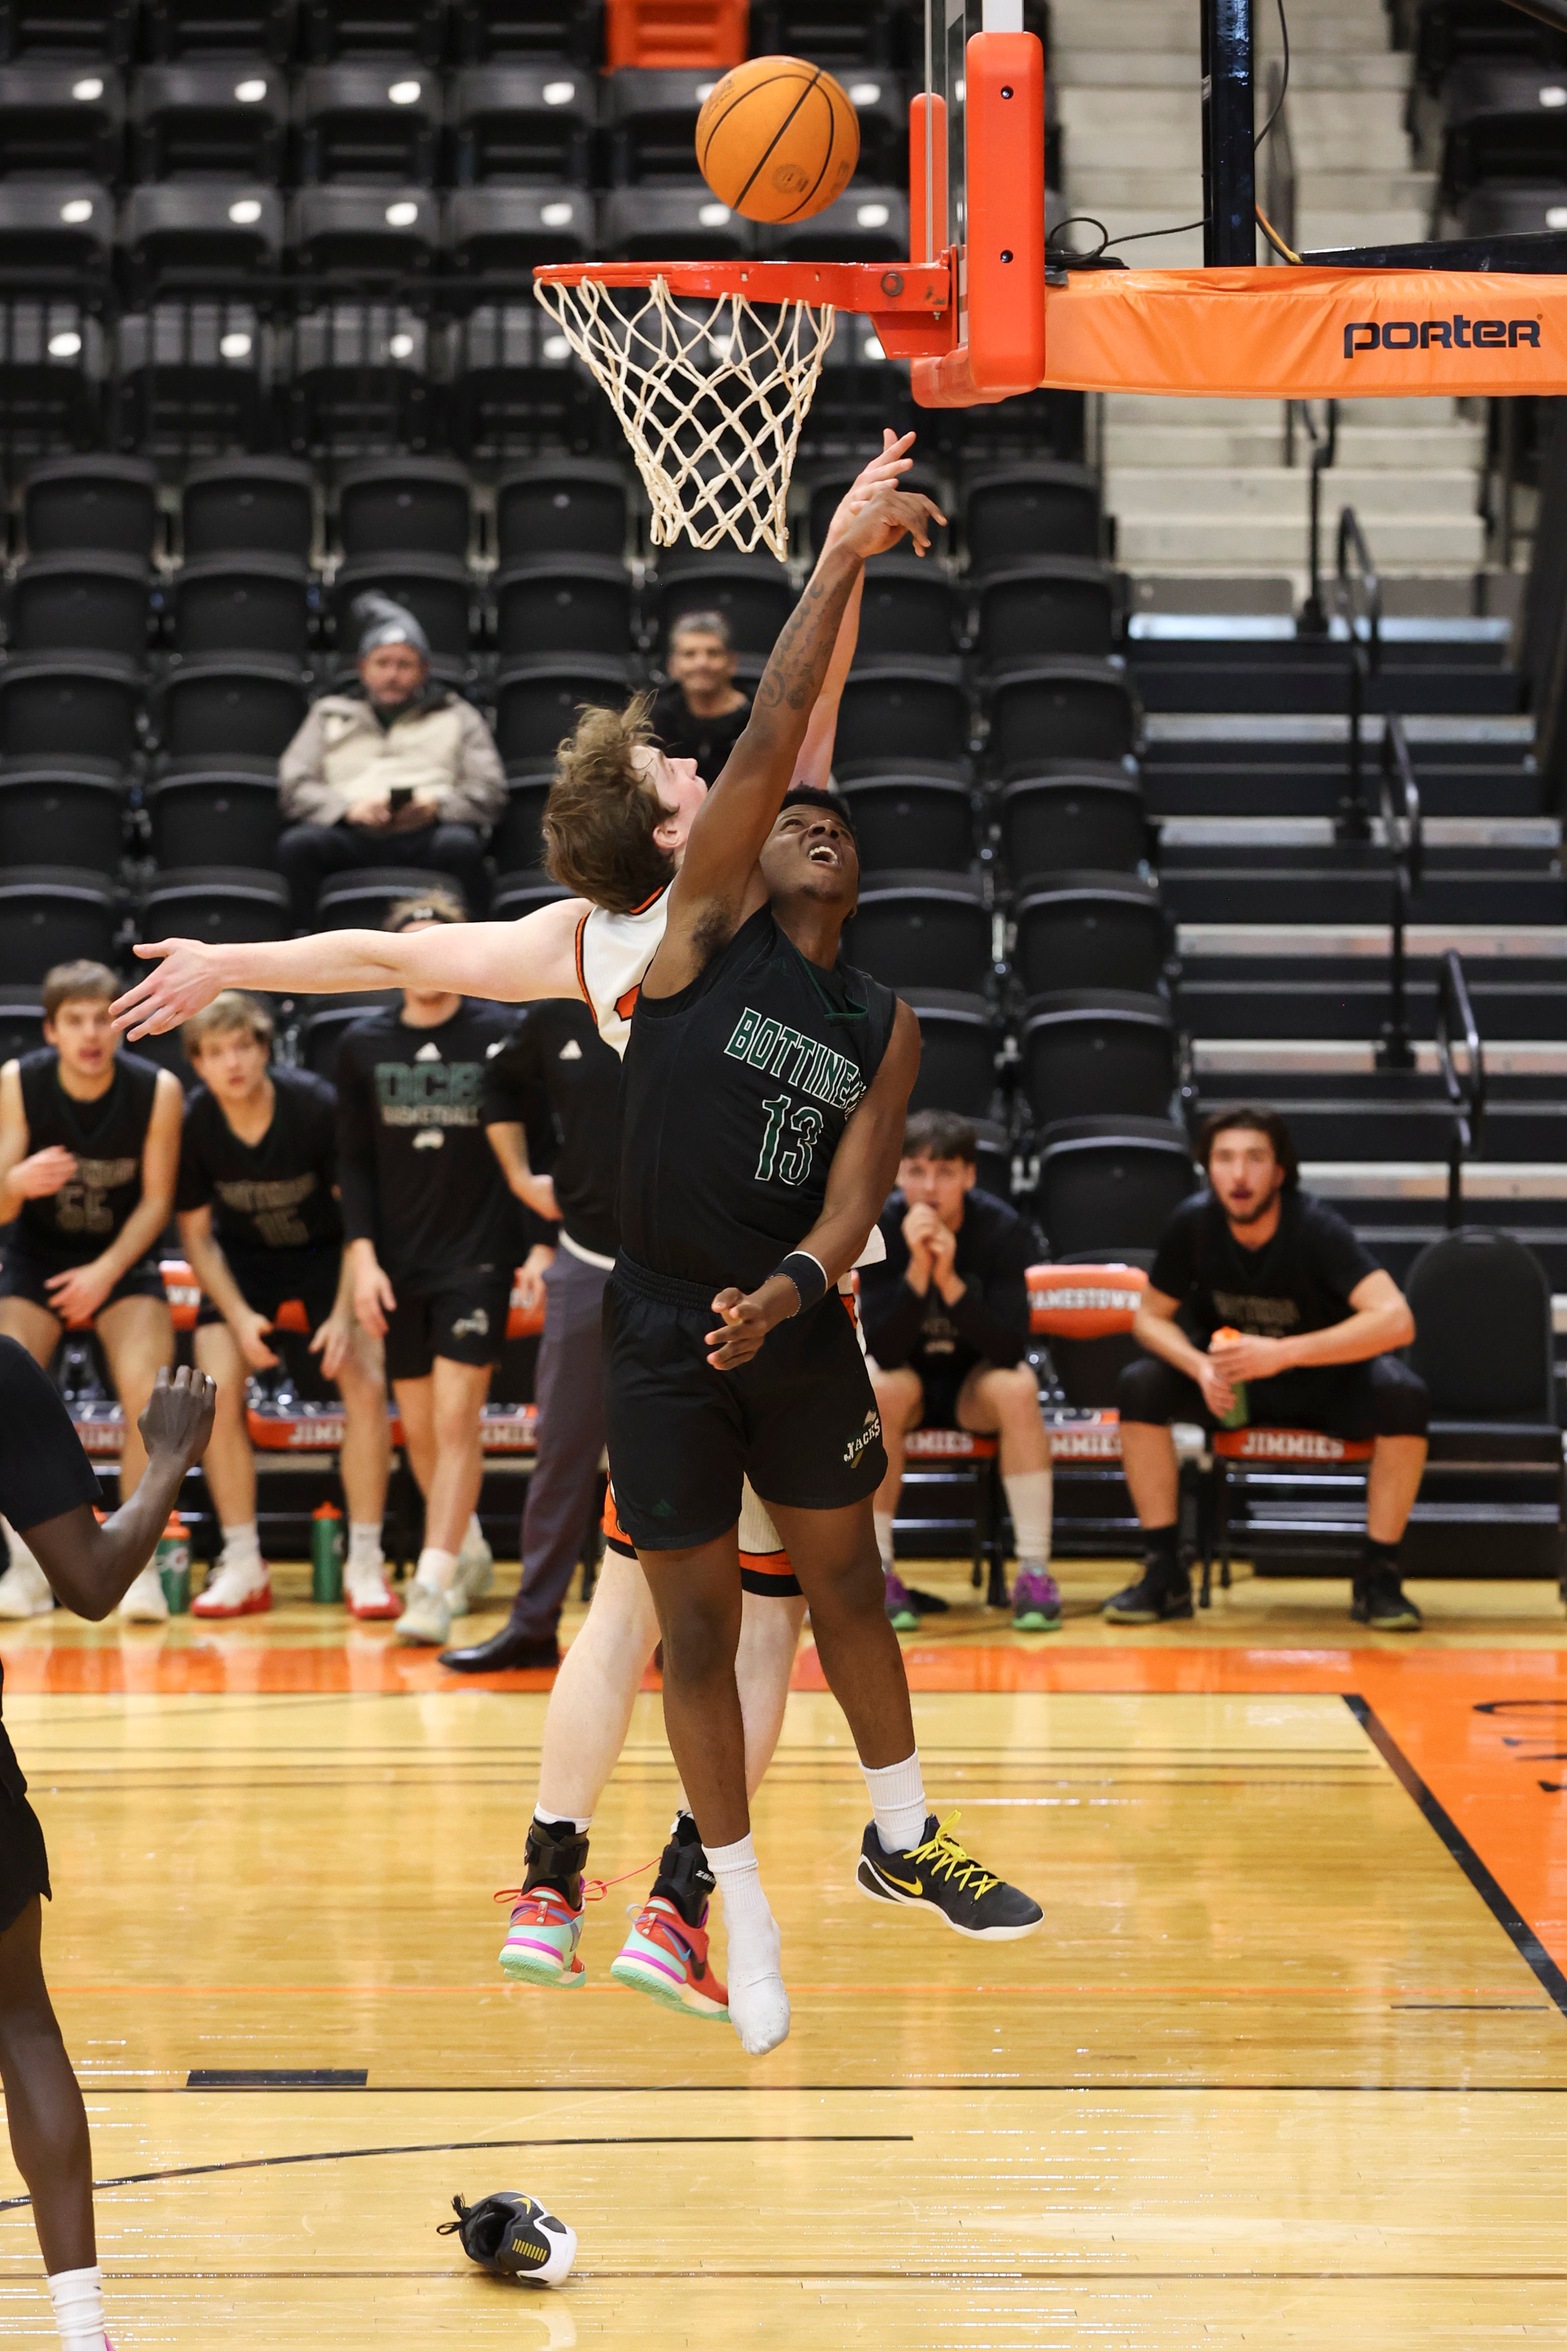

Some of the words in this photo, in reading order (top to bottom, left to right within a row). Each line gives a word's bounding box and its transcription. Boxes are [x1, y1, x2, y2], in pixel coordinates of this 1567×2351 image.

[1344, 315, 1541, 358] porter
[374, 1061, 484, 1106] DCB
[755, 1094, 824, 1186] 13
[844, 1417, 881, 1462] JACKS
[1241, 1432, 1345, 1458] JIMMIES
